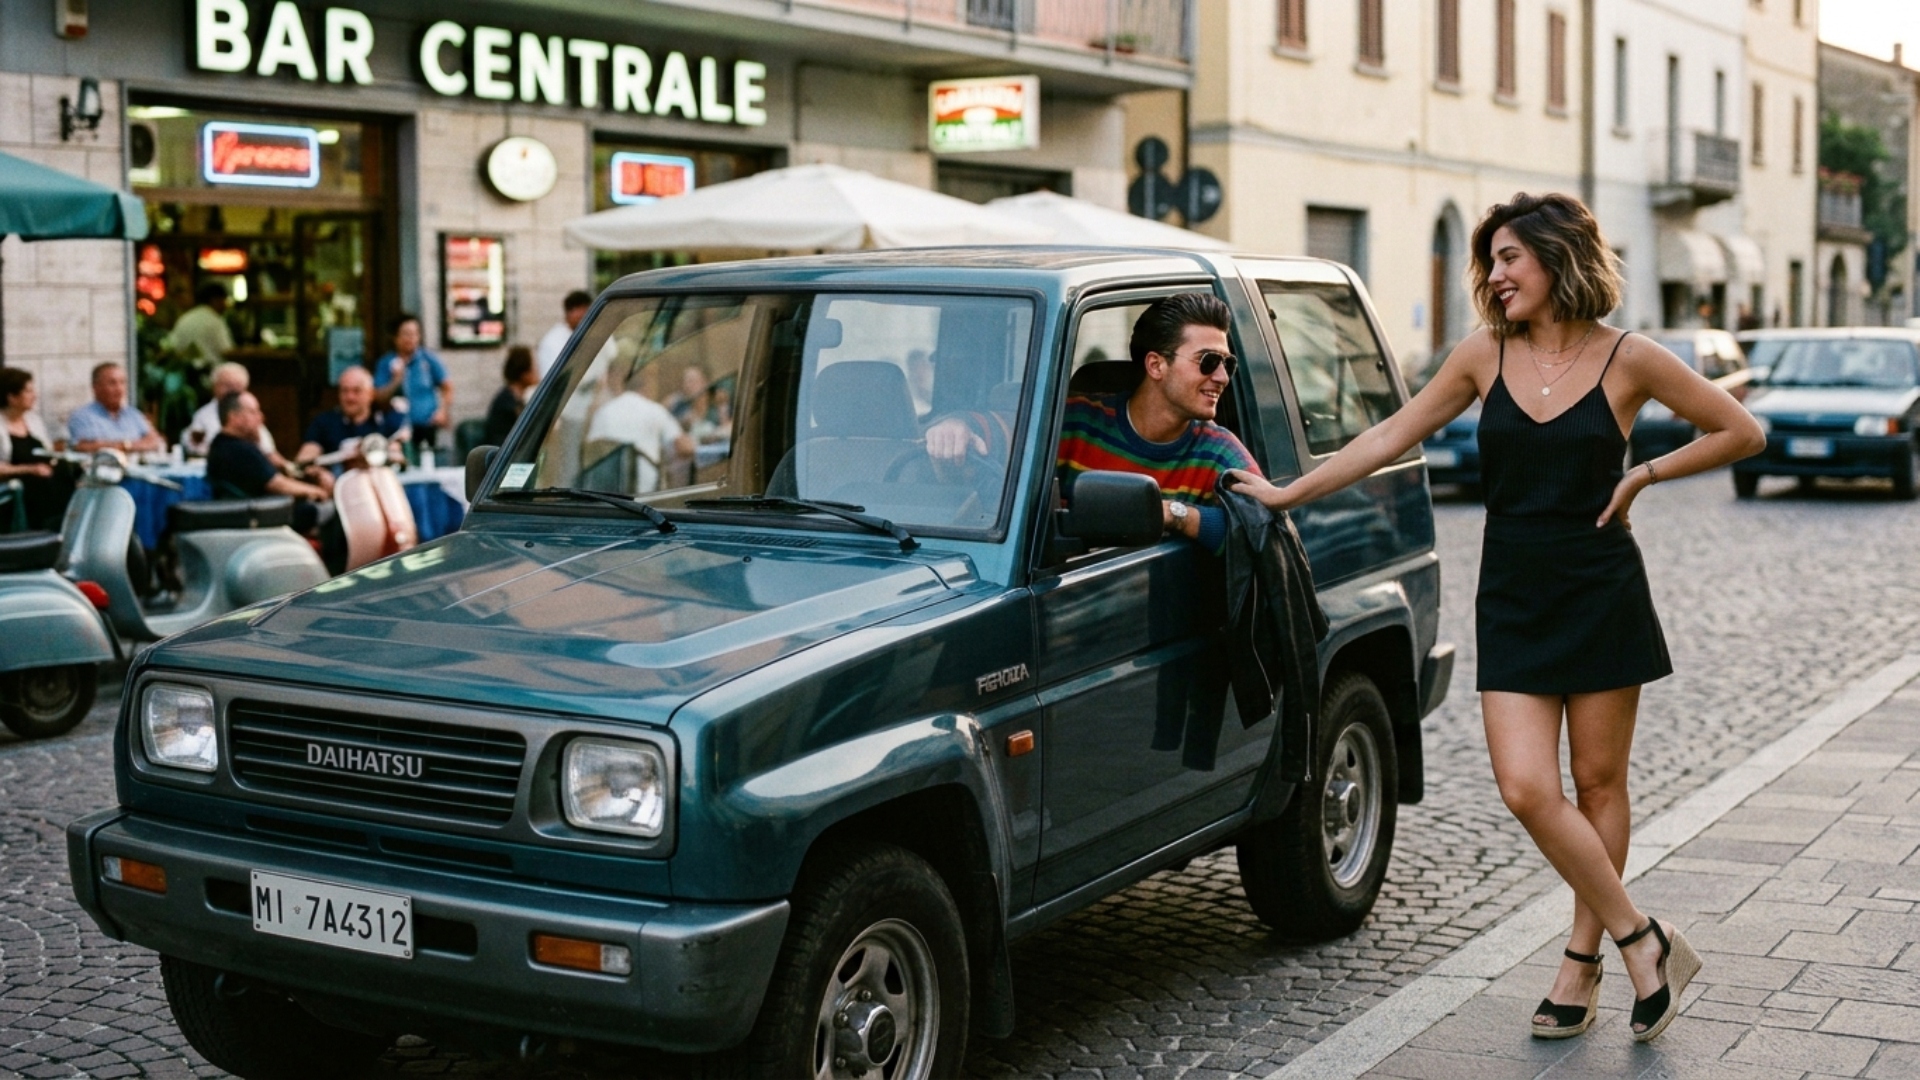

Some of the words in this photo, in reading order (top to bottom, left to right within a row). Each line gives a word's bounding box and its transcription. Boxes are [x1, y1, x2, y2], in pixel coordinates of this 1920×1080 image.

[196, 0, 375, 85] BAR
[420, 20, 767, 126] CENTRALE
[307, 743, 423, 778] DAIHATSU
[256, 885, 283, 924] MI
[306, 895, 407, 946] 7A4312
